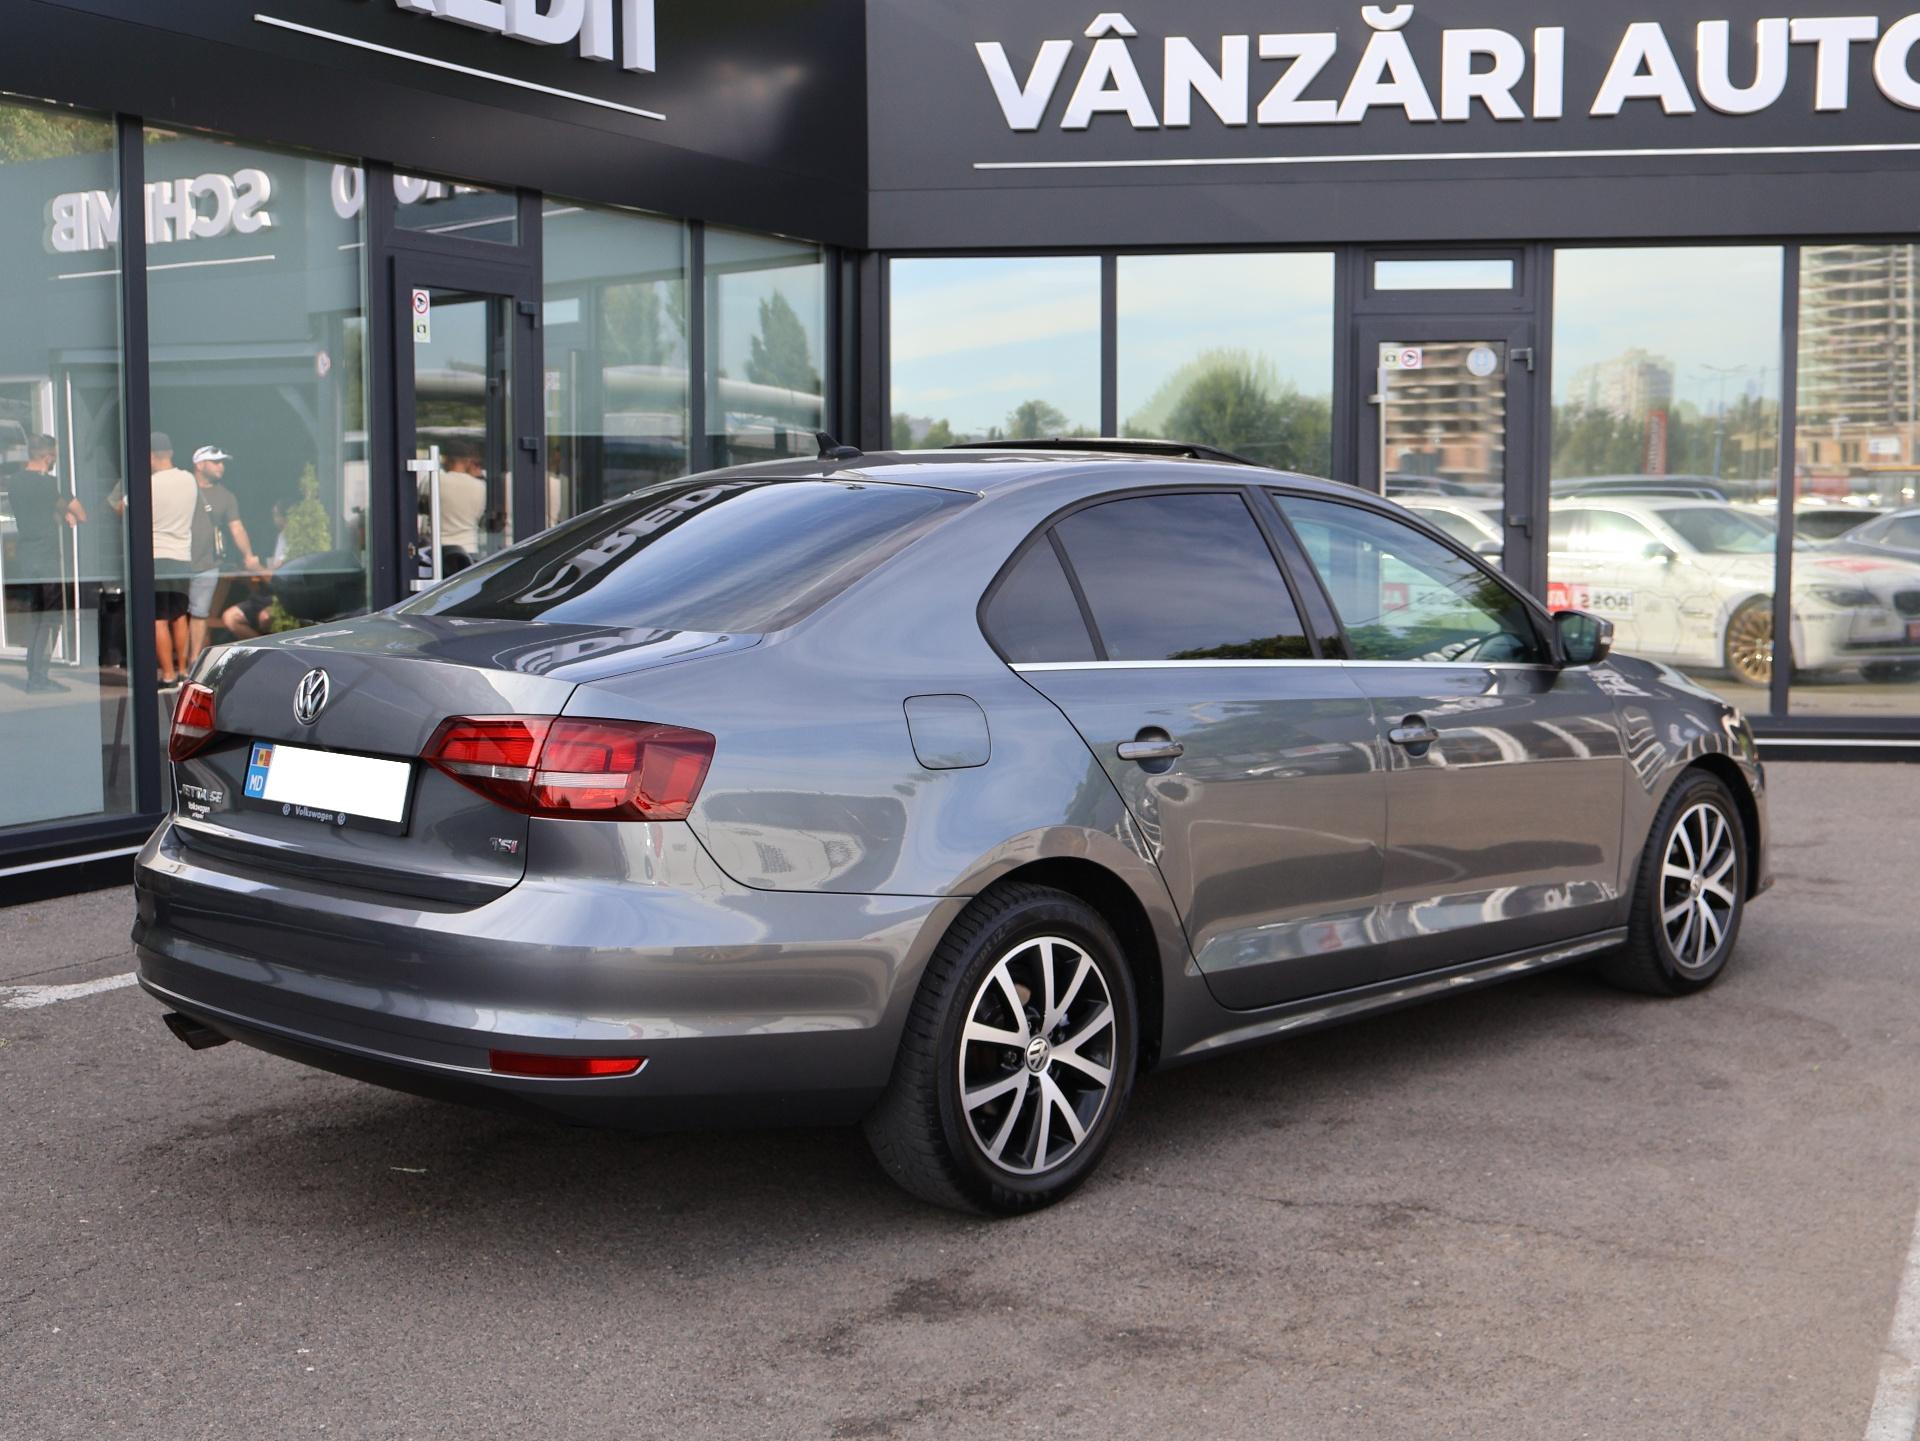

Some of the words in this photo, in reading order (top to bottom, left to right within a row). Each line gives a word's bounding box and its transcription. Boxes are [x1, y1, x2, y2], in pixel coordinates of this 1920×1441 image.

[974, 4, 1564, 131] VÂNZĂRI
[249, 774, 263, 791] MD
[295, 804, 333, 823] Volkswagen
[489, 837, 518, 854] TSI
